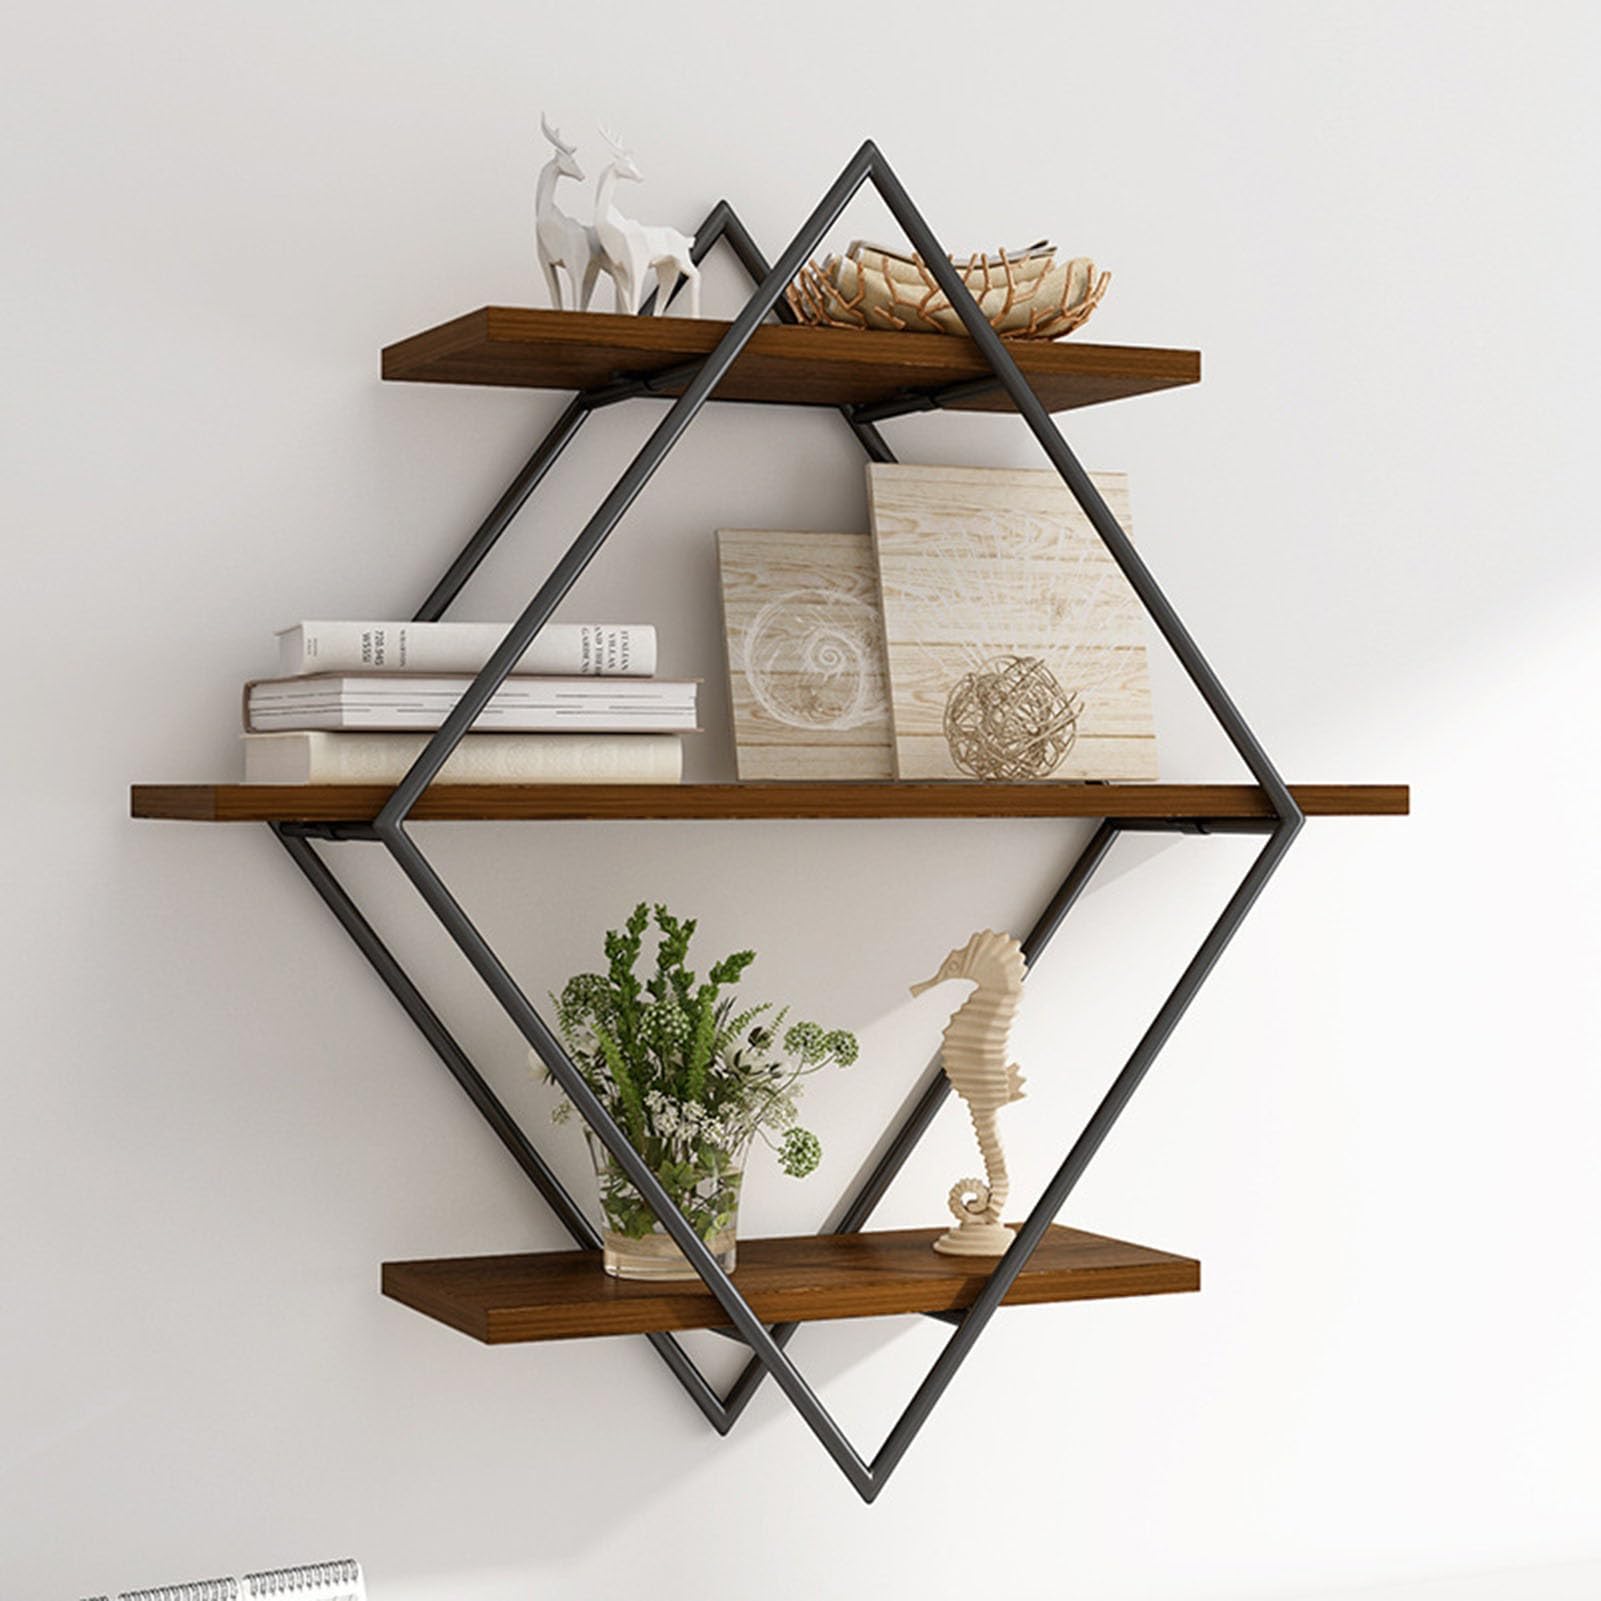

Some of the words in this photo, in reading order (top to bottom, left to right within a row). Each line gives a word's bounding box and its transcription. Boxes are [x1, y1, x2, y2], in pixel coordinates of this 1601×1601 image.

[581, 627, 591, 673] GARDENS
[607, 632, 617, 669] VILLAS
[620, 630, 630, 671] ITALIAN
